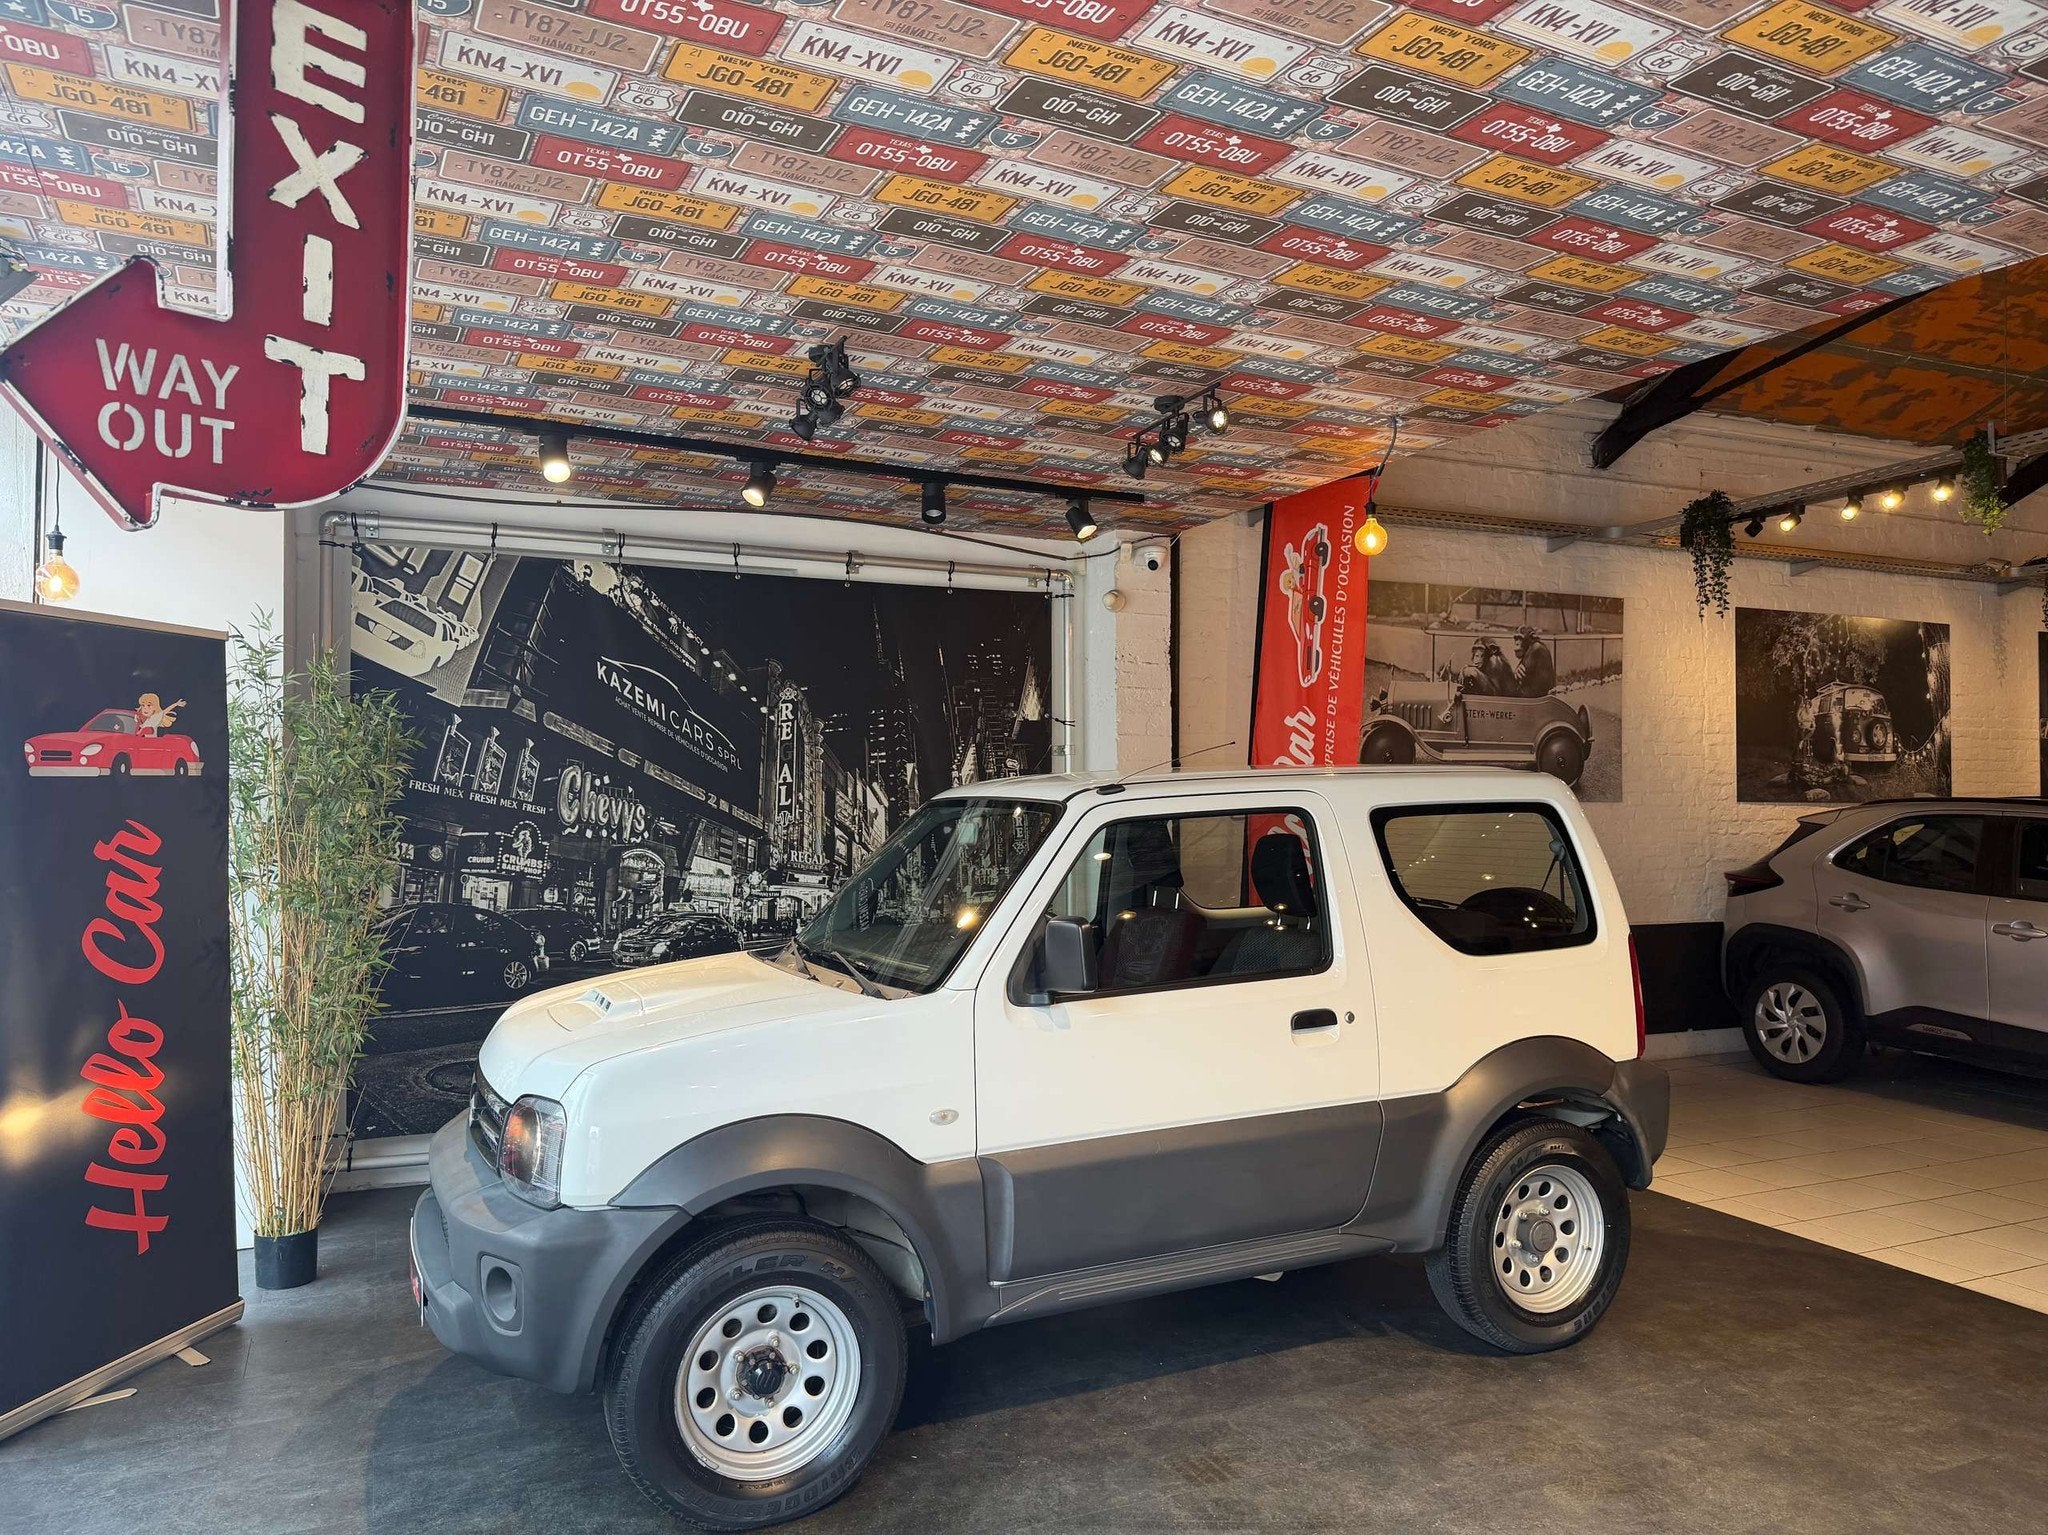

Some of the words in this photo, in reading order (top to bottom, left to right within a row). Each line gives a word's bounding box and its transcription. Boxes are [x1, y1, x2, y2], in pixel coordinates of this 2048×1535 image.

[70, 7, 95, 24] 15
[1803, 11, 1836, 25] NEW
[1834, 20, 1868, 37] YORK
[1428, 25, 1462, 38] NEW
[1464, 34, 1500, 51] YORK
[688, 48, 703, 58] 21
[1065, 40, 1100, 53] NEW
[1105, 49, 1142, 65] YORK
[1649, 56, 1675, 69] 66
[717, 55, 752, 67] NEW
[759, 64, 799, 79] YORK
[1298, 71, 1322, 83] 66
[636, 85, 663, 94] ROUTE
[809, 77, 826, 87] 82
[960, 83, 982, 95] 66
[1517, 70, 1613, 108] GEH-142A
[632, 95, 655, 107] 66
[1177, 84, 1277, 121] GEH-142A
[529, 106, 639, 141] GEH-142A
[848, 96, 953, 132] GEH-142A
[1639, 110, 1667, 124] 15
[1000, 132, 1022, 145] 15
[1314, 123, 1339, 136] 15
[696, 141, 715, 154] 15
[264, 0, 370, 456] EXIT
[96, 338, 240, 411] WAY
[98, 401, 236, 465] OUT
[1326, 605, 1346, 690] VÉHICULES
[596, 660, 667, 721] KAZEMI
[669, 710, 715, 751] CARS
[717, 746, 743, 771] SPRL
[1326, 692, 1338, 716] DE
[778, 702, 795, 806] REGAL
[409, 780, 440, 794] FRESH
[443, 787, 464, 799] MEX
[469, 792, 497, 805] FRESH
[500, 798, 519, 809] MEX
[522, 803, 547, 815] FRESH
[557, 765, 646, 843] Chevys
[467, 856, 495, 864] CRUMBS
[501, 853, 544, 869] CRUMBS
[80, 817, 163, 985] Car
[79, 997, 170, 1256] Hello
